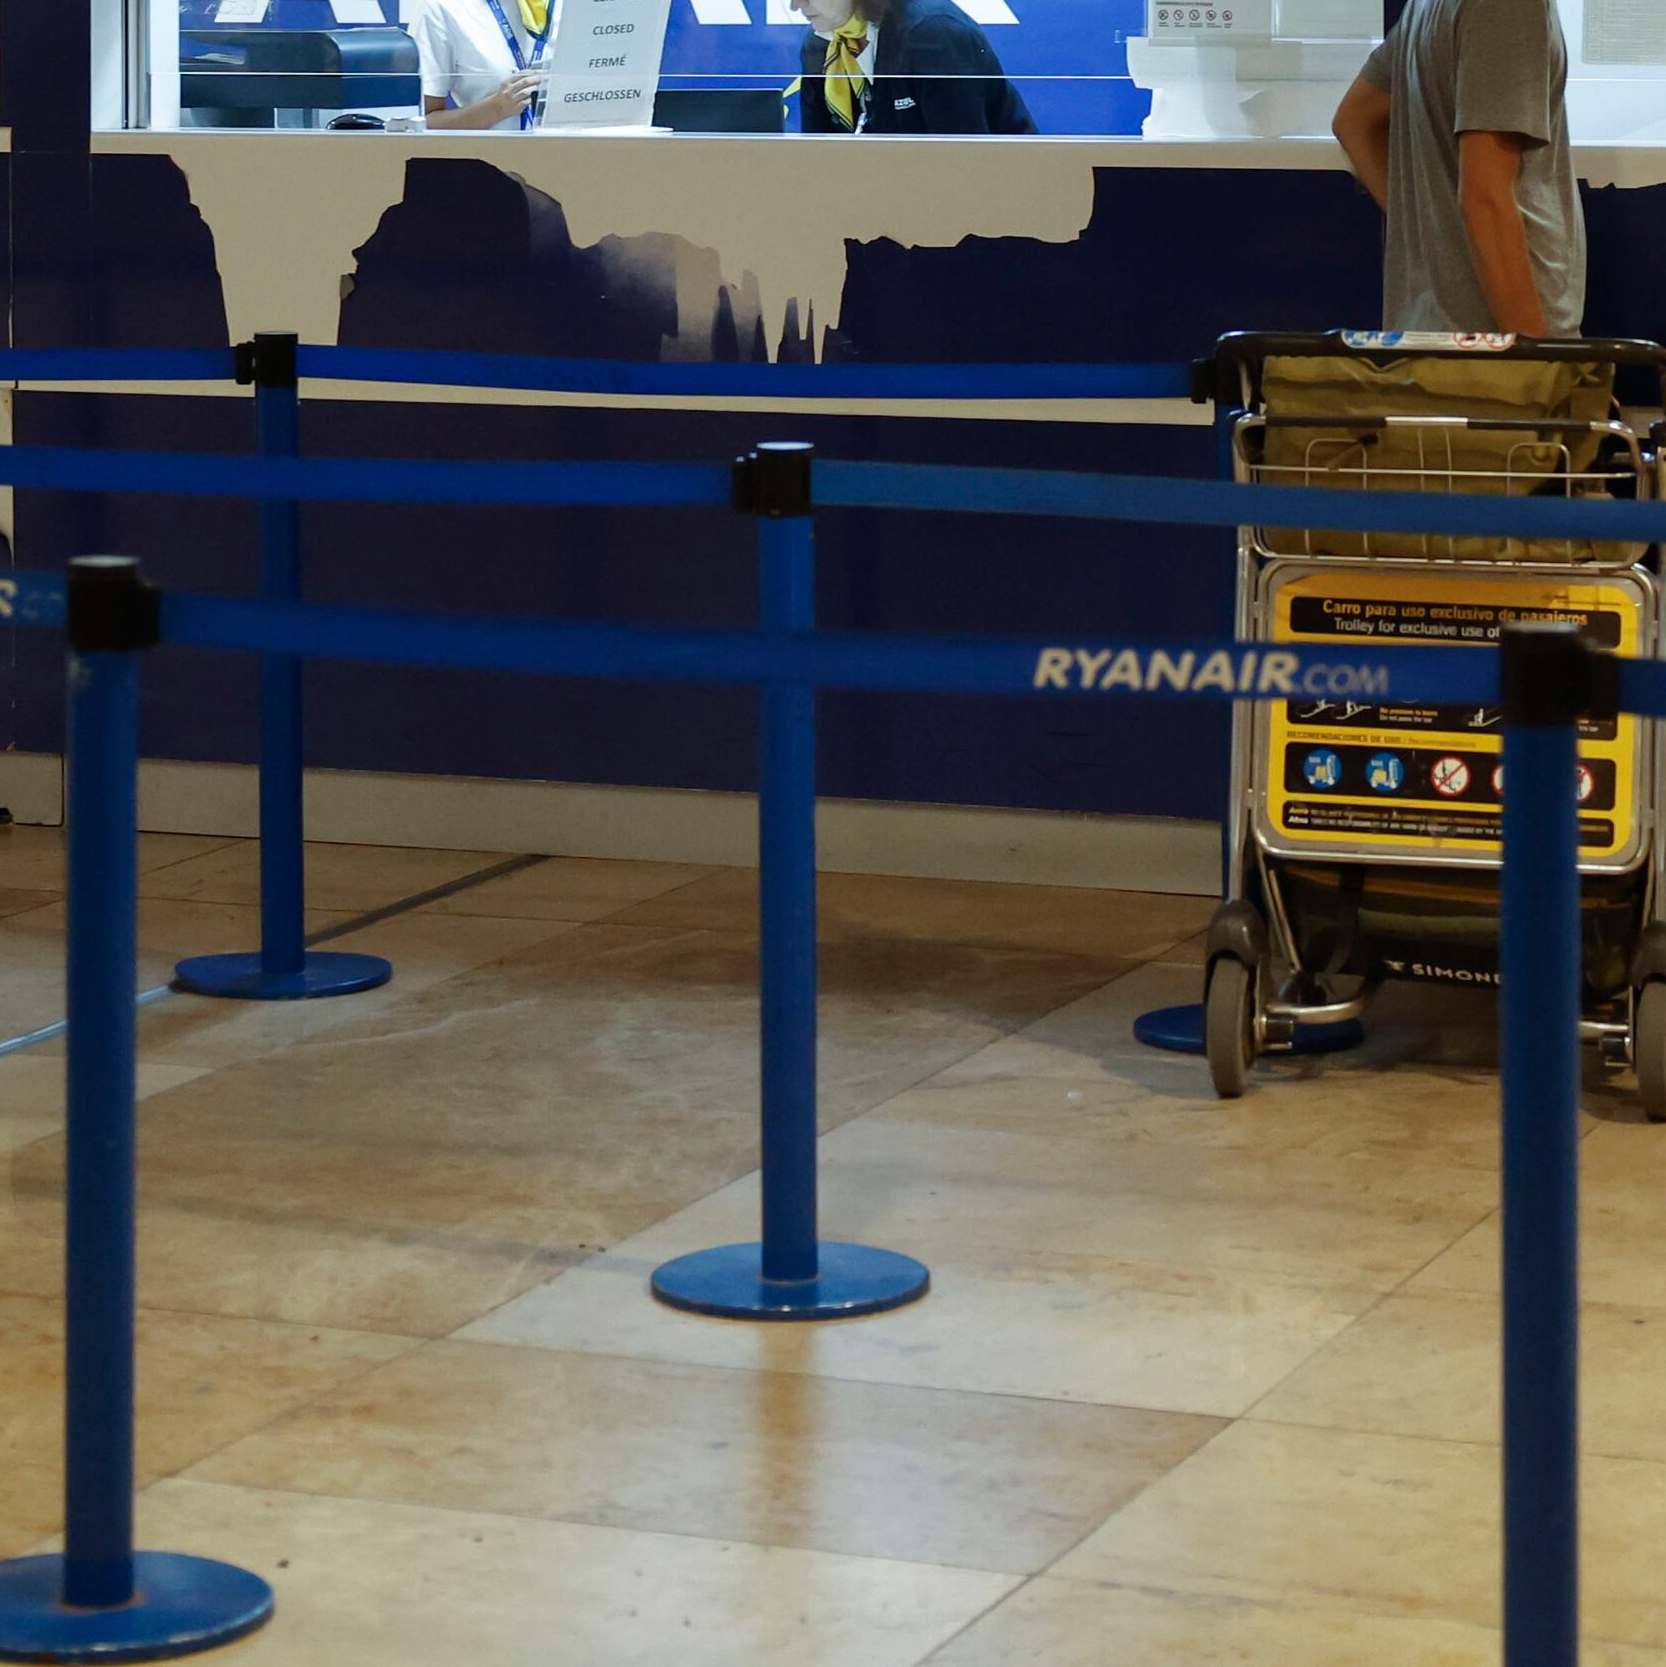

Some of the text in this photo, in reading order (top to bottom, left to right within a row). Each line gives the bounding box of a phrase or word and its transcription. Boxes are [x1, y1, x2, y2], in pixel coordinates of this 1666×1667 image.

[592, 23, 635, 36] CLOSED
[588, 54, 627, 68] FERMÉ
[564, 89, 641, 103] GESCHLOSSEN
[1323, 600, 1361, 615] Carro
[1365, 605, 1396, 618] para
[1401, 606, 1425, 618] uso
[1430, 605, 1494, 621] exclusivo
[1498, 608, 1516, 622] de
[1335, 617, 1502, 638] Trolley for exclusive use of
[1034, 647, 1389, 694] RYANAIR.COM
